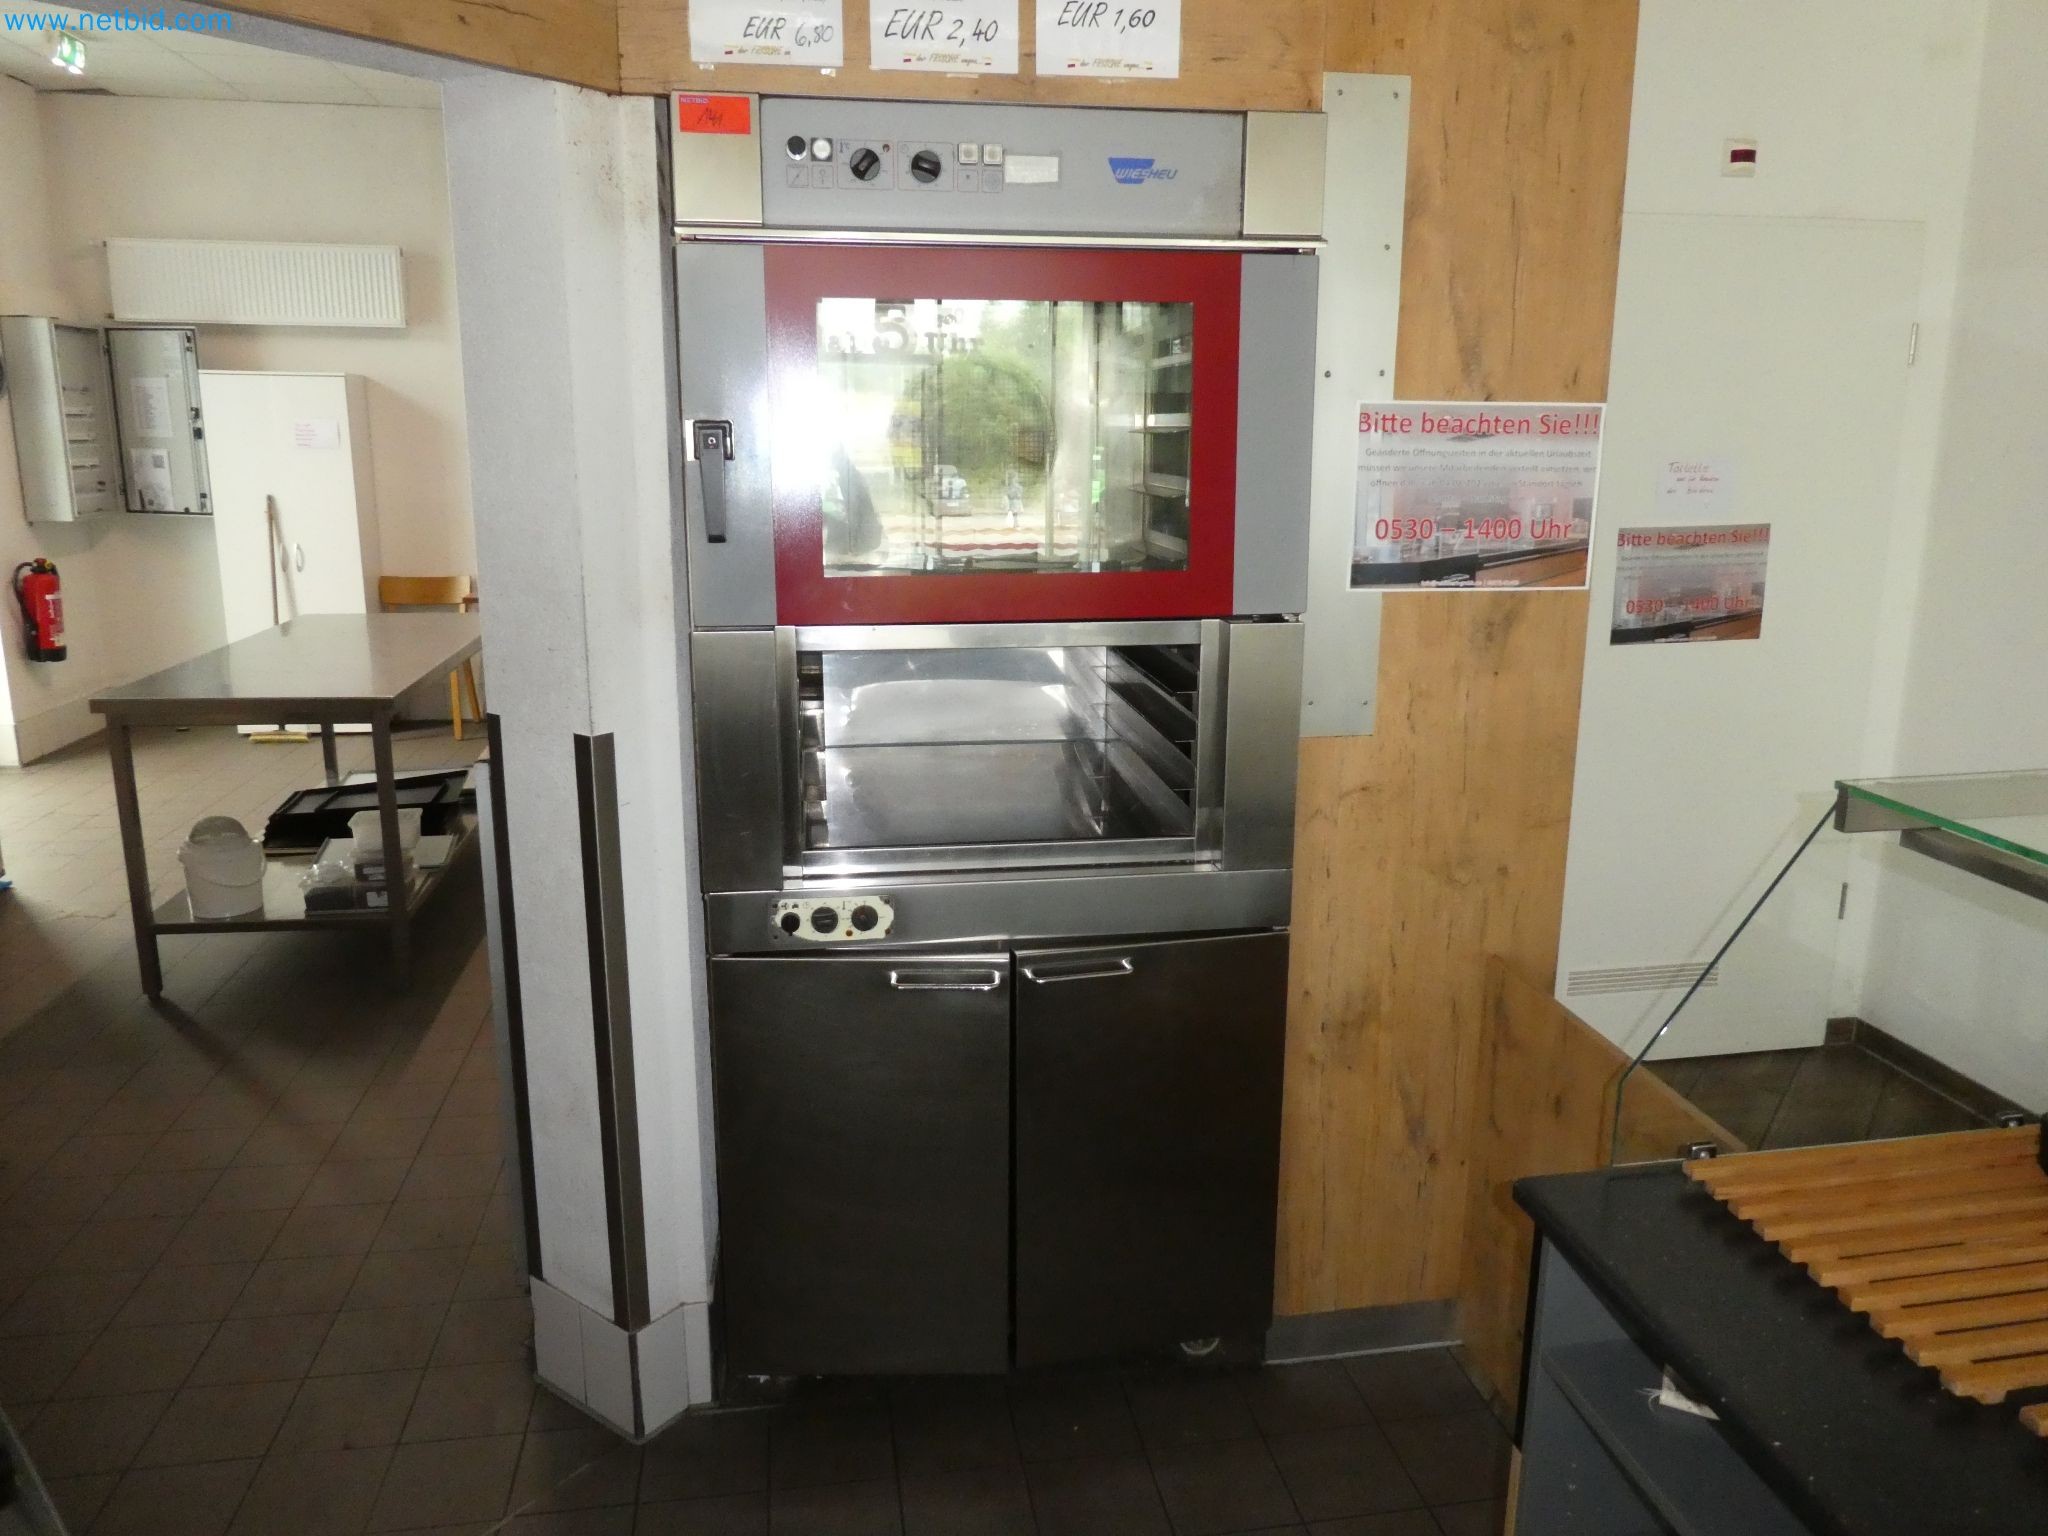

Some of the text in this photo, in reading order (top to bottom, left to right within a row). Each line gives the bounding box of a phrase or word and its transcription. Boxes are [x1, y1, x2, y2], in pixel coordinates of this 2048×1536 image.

[884, 8, 999, 48] EUR 2,40
[1057, 0, 1156, 34] EUR 1,60
[743, 15, 834, 47] EUR 6,80
[1115, 168, 1178, 180] WIESHEU
[1359, 411, 1599, 435] Bitte beachten Sie!!!
[1375, 518, 1433, 540] 0530
[1463, 518, 1522, 540] 1400
[1530, 517, 1572, 539] Uhr
[1617, 532, 1651, 547] Bitte
[1657, 530, 1726, 546] beachten
[1626, 599, 1664, 615] 0530
